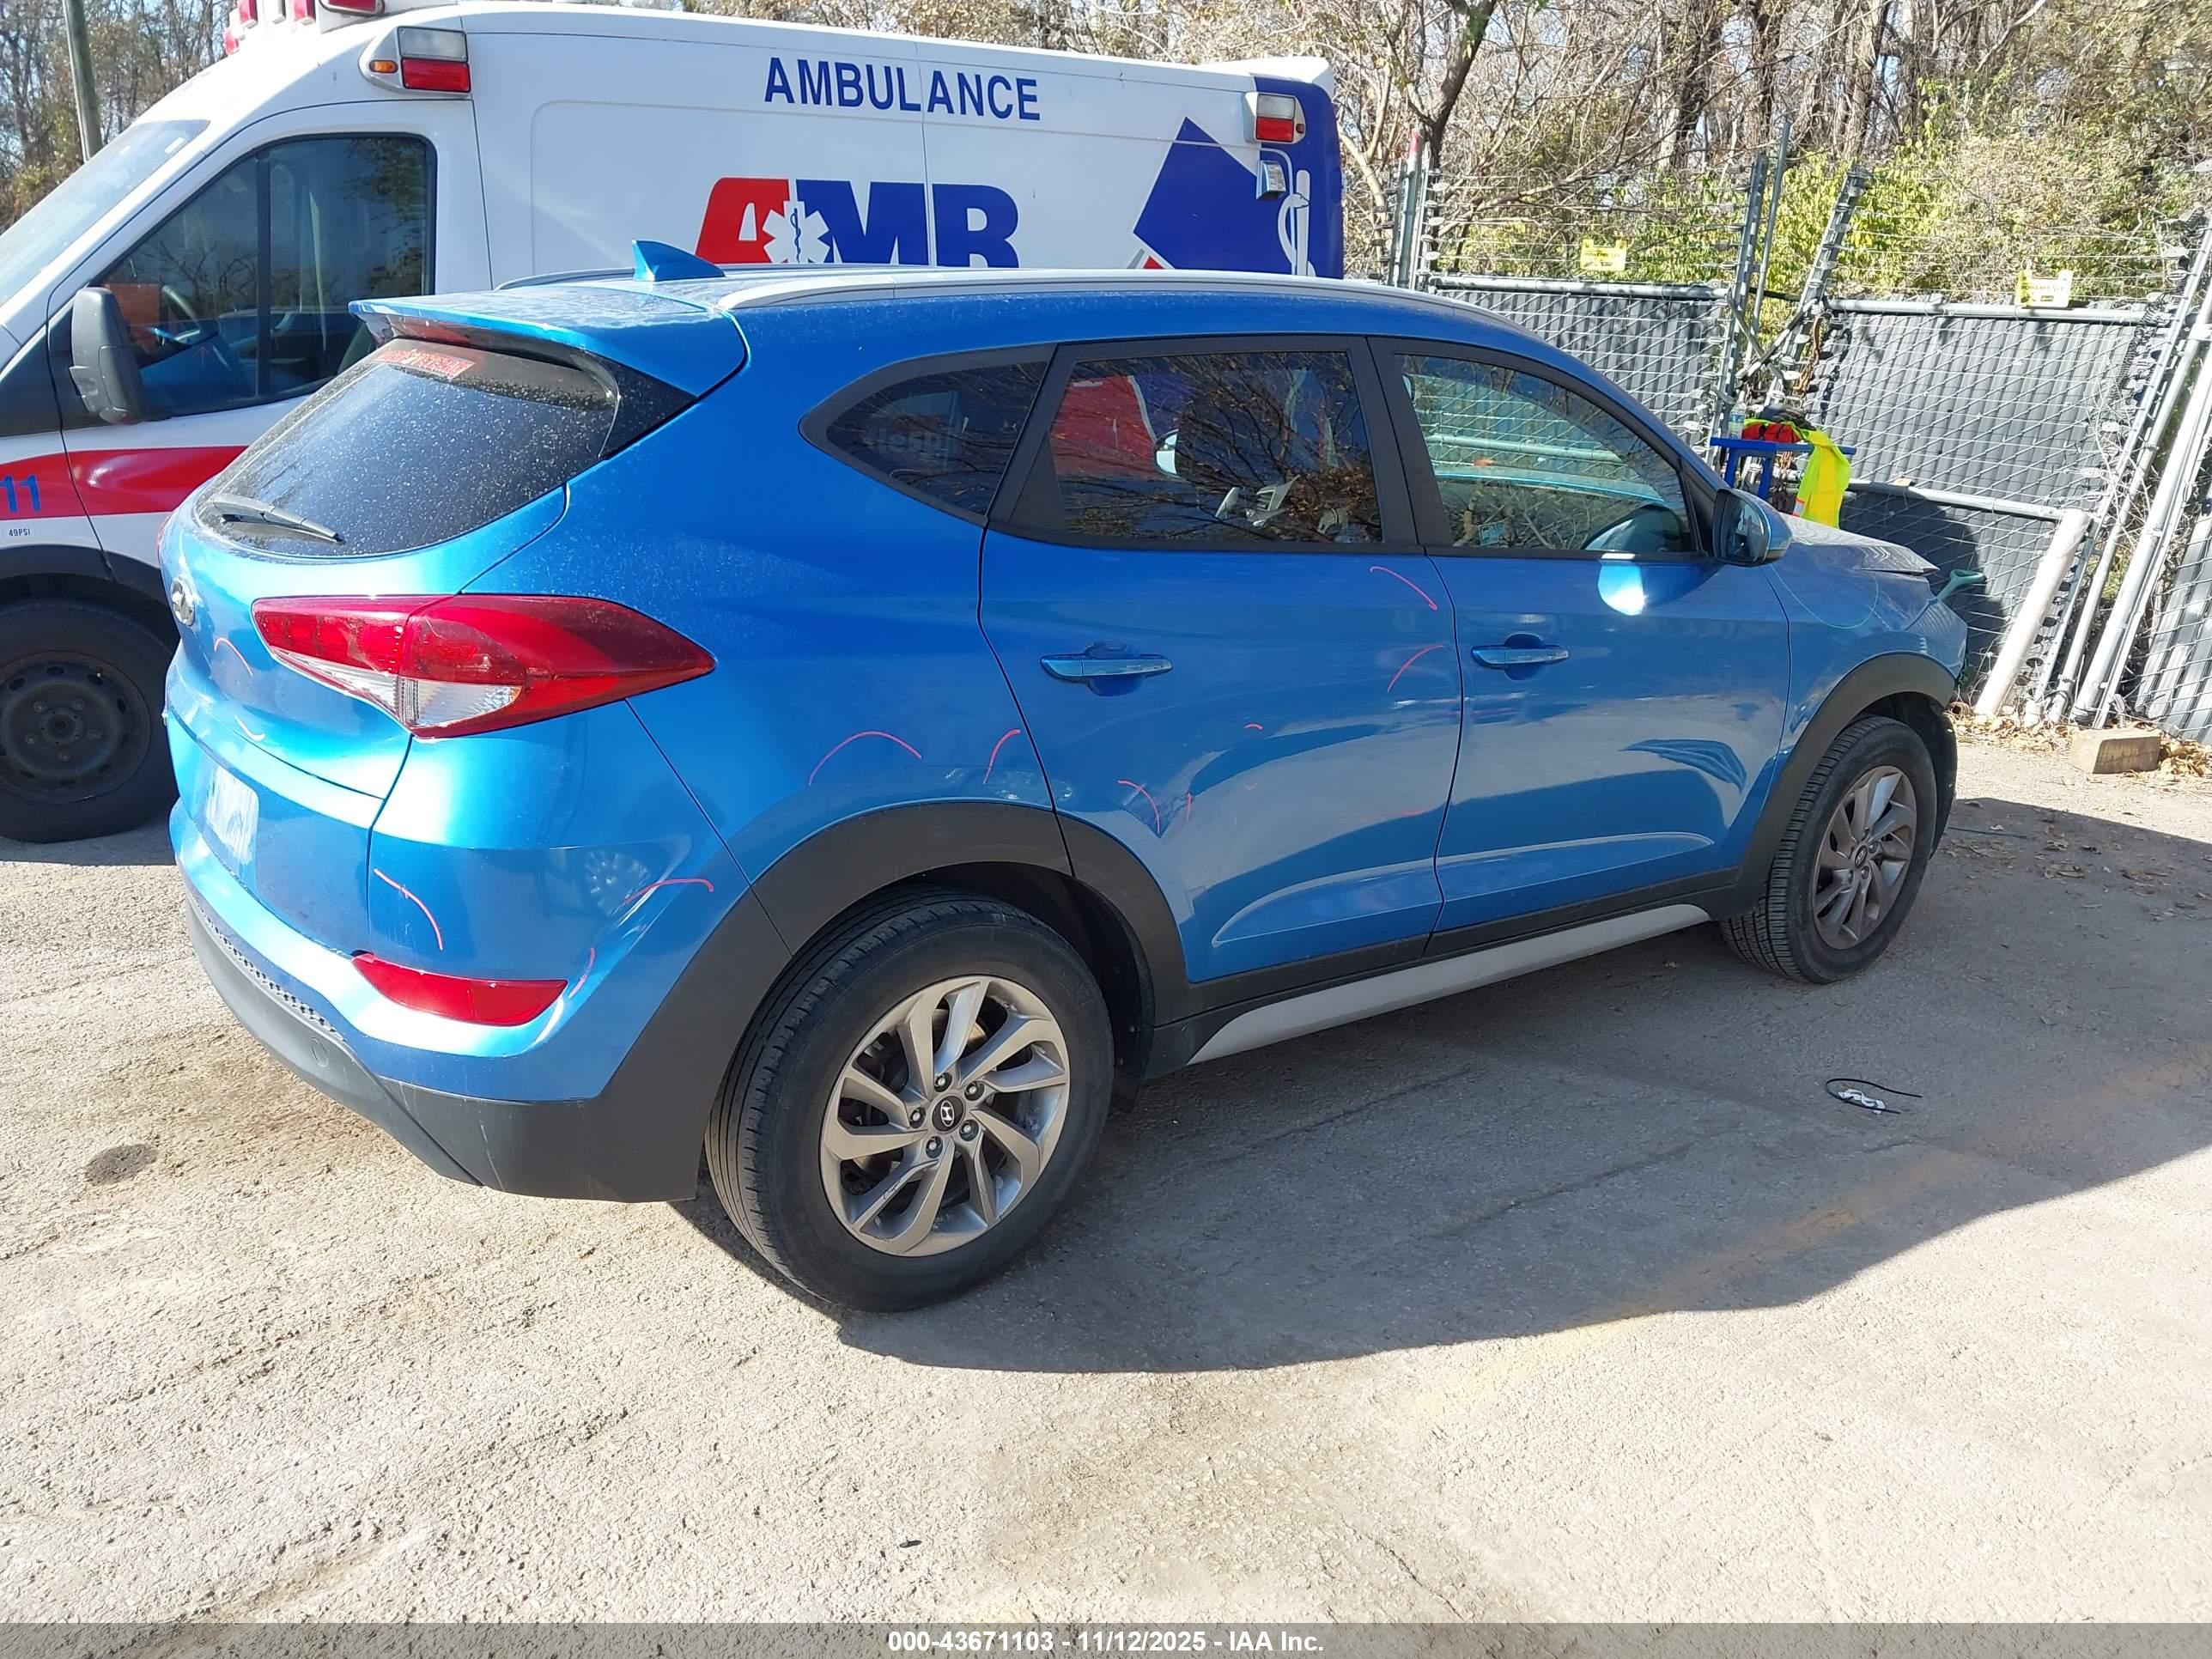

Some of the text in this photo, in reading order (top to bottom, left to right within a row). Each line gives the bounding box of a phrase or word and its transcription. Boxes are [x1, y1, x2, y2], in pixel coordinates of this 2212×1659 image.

[764, 57, 1041, 121] AMBULANCE
[695, 177, 1020, 268] AMR
[9, 528, 31, 537] 49PSI
